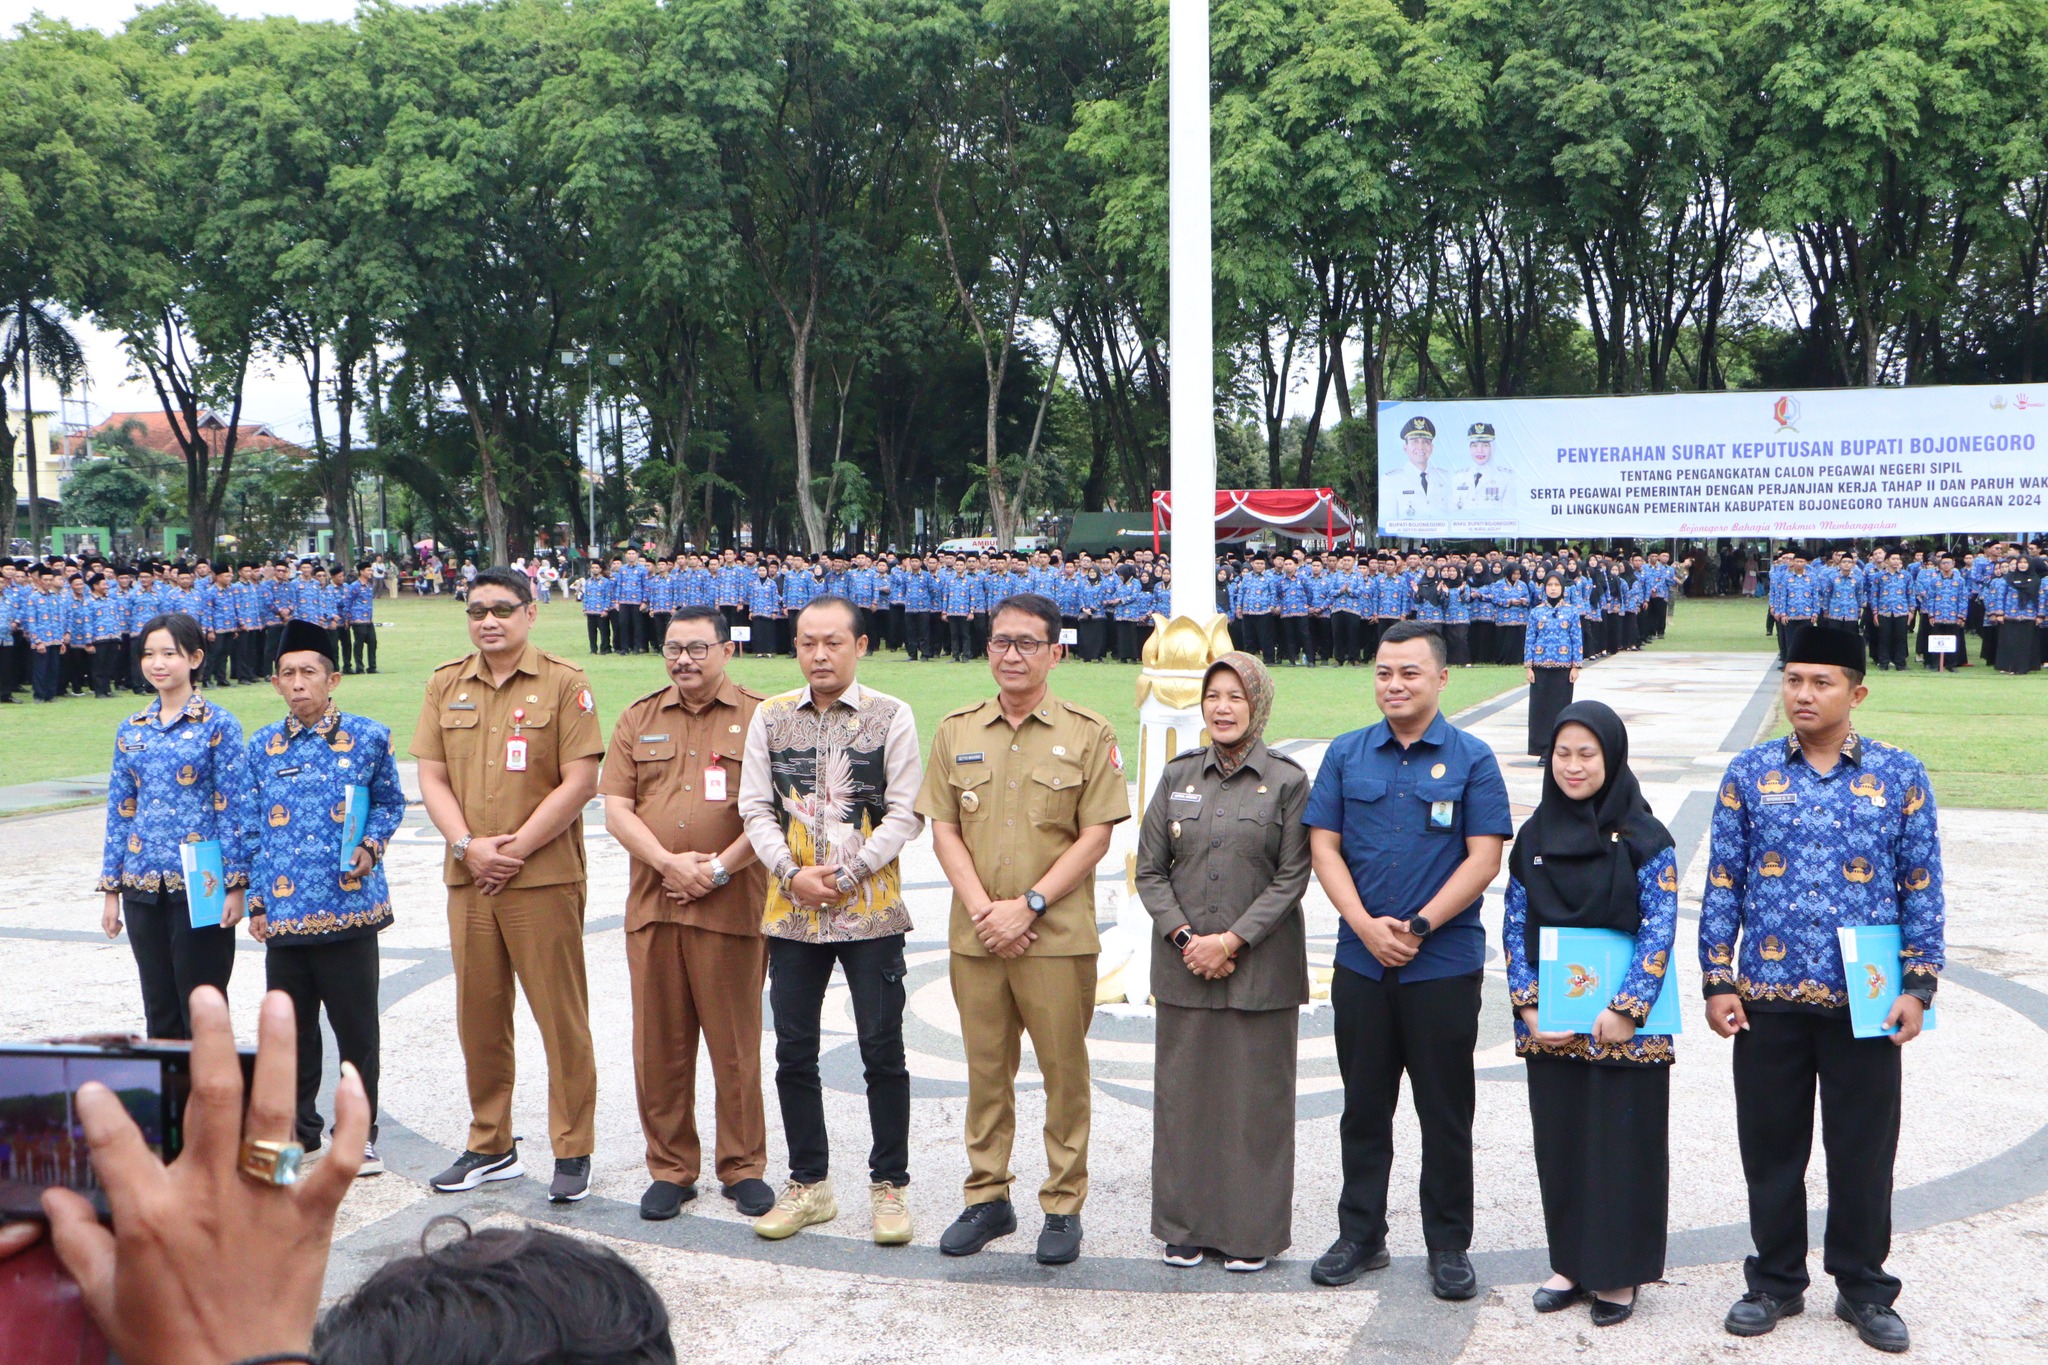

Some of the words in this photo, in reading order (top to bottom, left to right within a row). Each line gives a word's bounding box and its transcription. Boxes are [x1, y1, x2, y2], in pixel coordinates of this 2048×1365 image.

[1558, 446, 1666, 462] PENYERAHAN
[1672, 444, 1725, 460] SURAT
[1733, 441, 1833, 458] KEPUTUSAN
[1841, 439, 1902, 455] BUPATI
[1911, 434, 2034, 453] BOJONEGORO
[1621, 470, 1671, 481] TENTANG
[1677, 468, 1769, 479] PENGANGKATAN
[1775, 467, 1813, 477] CALON
[1819, 465, 1874, 476] PEGAWAI
[1880, 464, 1924, 475] NEGERI
[1931, 463, 1962, 473] SIPIL
[1531, 489, 1565, 499] SERTA
[1570, 488, 1620, 498] PEGAWAI
[1626, 486, 1701, 497] PEMERINTAH
[1706, 485, 1753, 495] DENGAN
[1759, 483, 1832, 494] PERJANJIAN
[1839, 482, 1876, 492] KERJA
[1882, 481, 1921, 491] TAHAP
[1928, 480, 1934, 490] II
[1941, 480, 1965, 490] DAN
[1971, 478, 2013, 489] PARUH
[2020, 477, 2048, 488] WAK
[1552, 505, 1562, 514] DI
[1567, 504, 1639, 514] LINGKUNGAN
[1645, 502, 1719, 513] PEMERINTAH
[1725, 501, 1793, 511] KABUPATEN
[1799, 498, 1882, 510] BOJONEGORO
[1888, 498, 1928, 508] TAHUN
[1933, 496, 2002, 507] ANGGARAN
[2008, 495, 2041, 506] 2024
[1679, 523, 1728, 534] Bojonegoro
[1731, 522, 1770, 533] Bahagia
[1774, 521, 1816, 530] Makmur
[1820, 520, 1897, 531] Membanggakan
